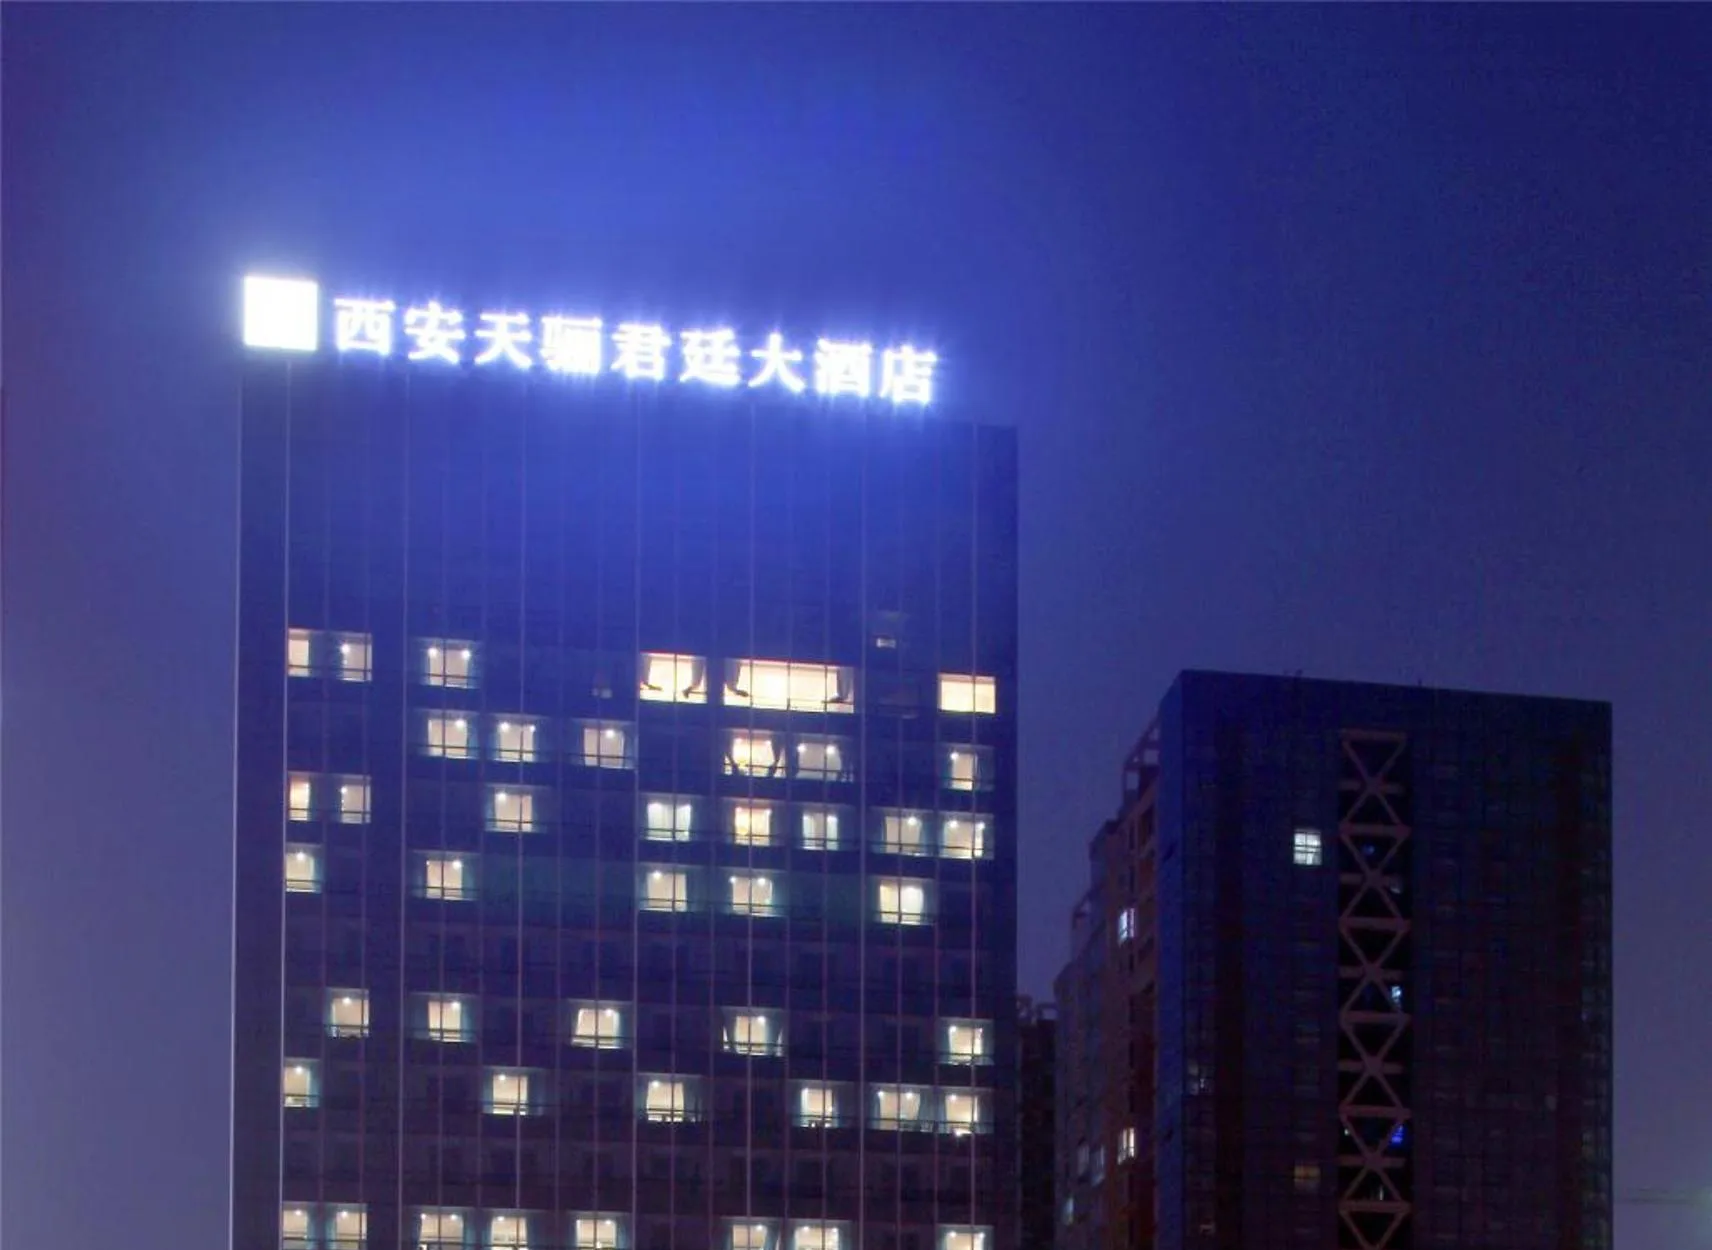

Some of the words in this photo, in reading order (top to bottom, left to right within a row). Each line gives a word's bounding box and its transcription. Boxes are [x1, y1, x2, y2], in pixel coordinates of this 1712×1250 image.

[334, 298, 936, 403] 西安天骊君廷大酒店
